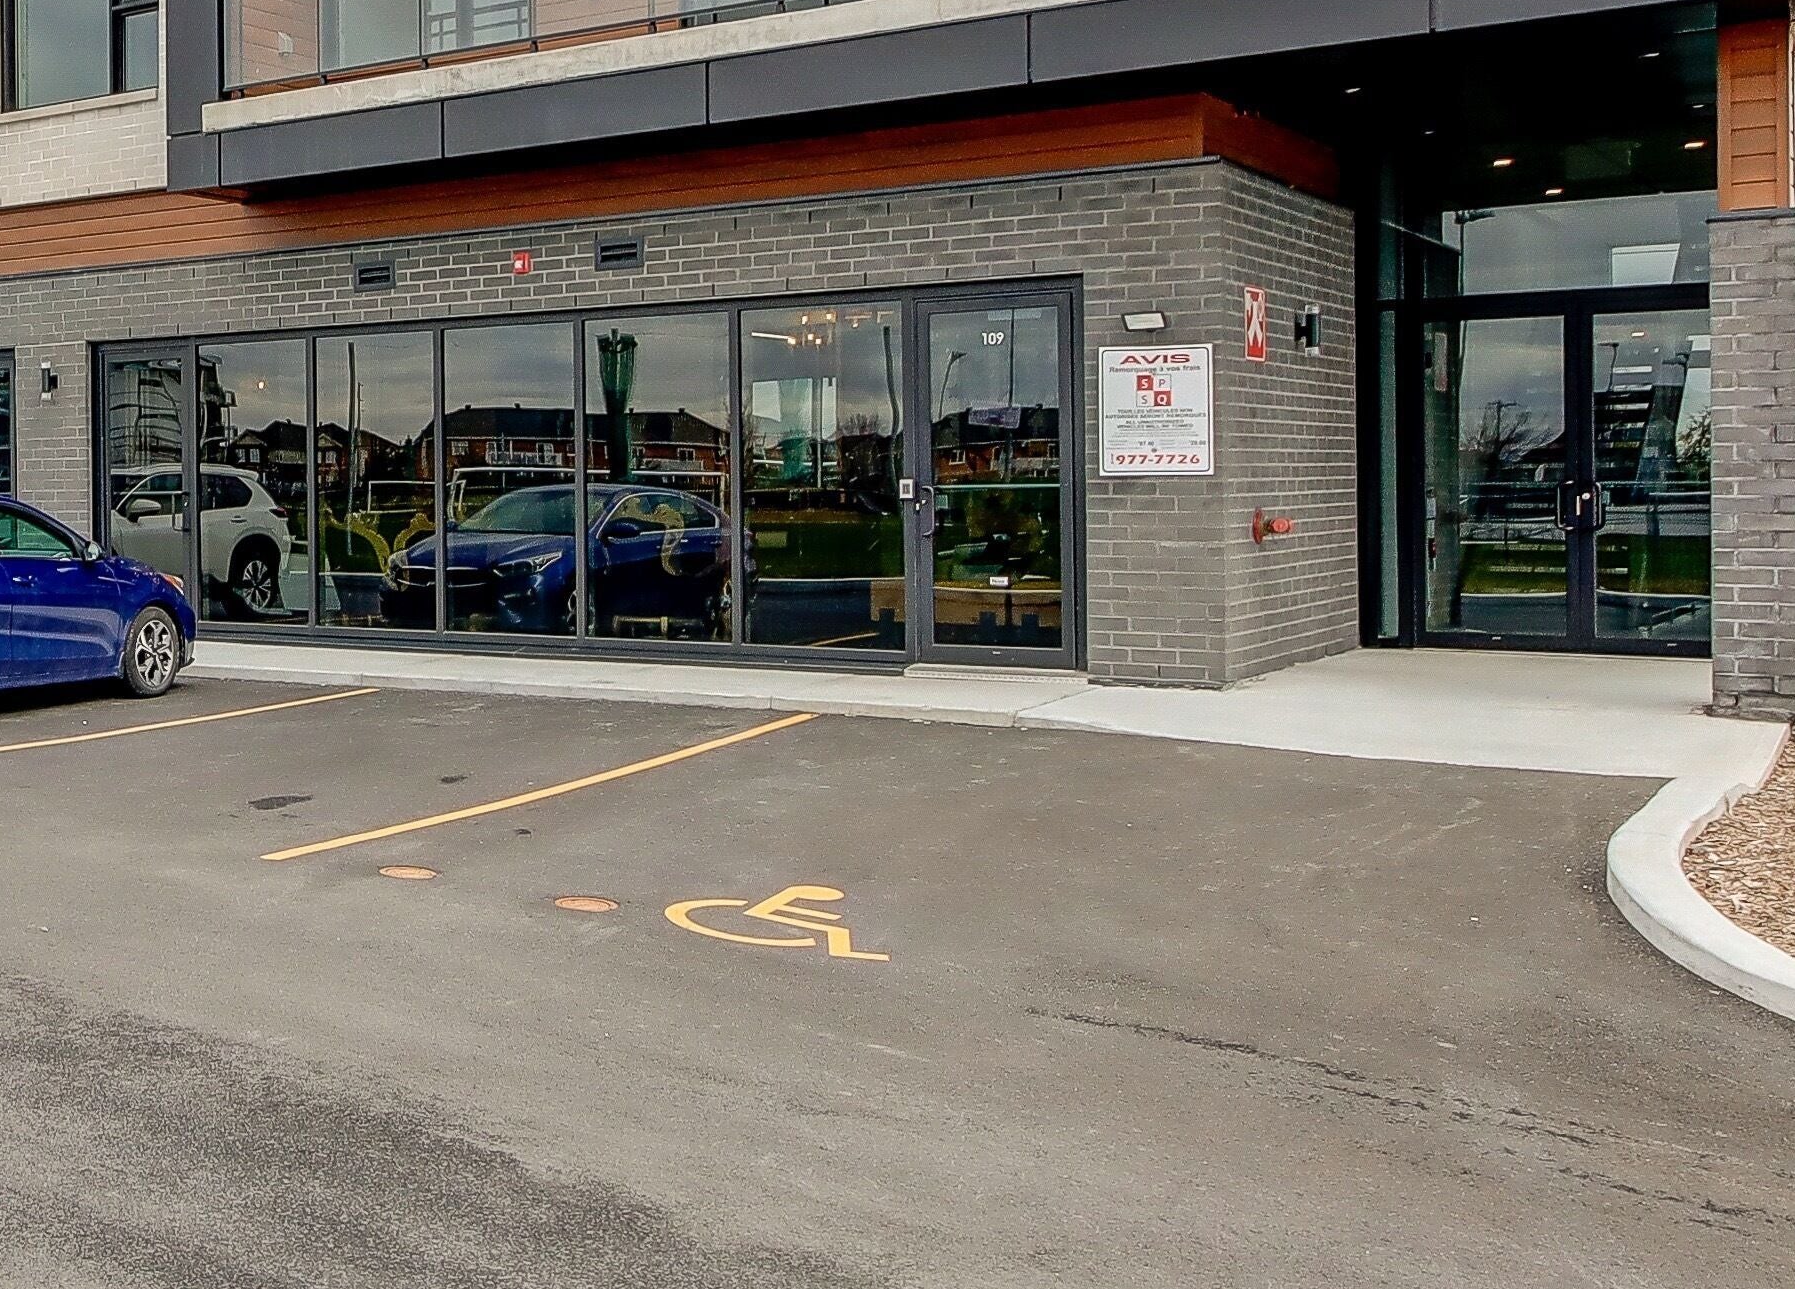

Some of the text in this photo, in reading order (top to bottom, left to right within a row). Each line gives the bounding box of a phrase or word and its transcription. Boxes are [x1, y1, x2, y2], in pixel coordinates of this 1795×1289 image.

[981, 331, 1005, 345] 109
[1120, 354, 1190, 364] AVIS
[1116, 454, 1200, 464] 977-7726
